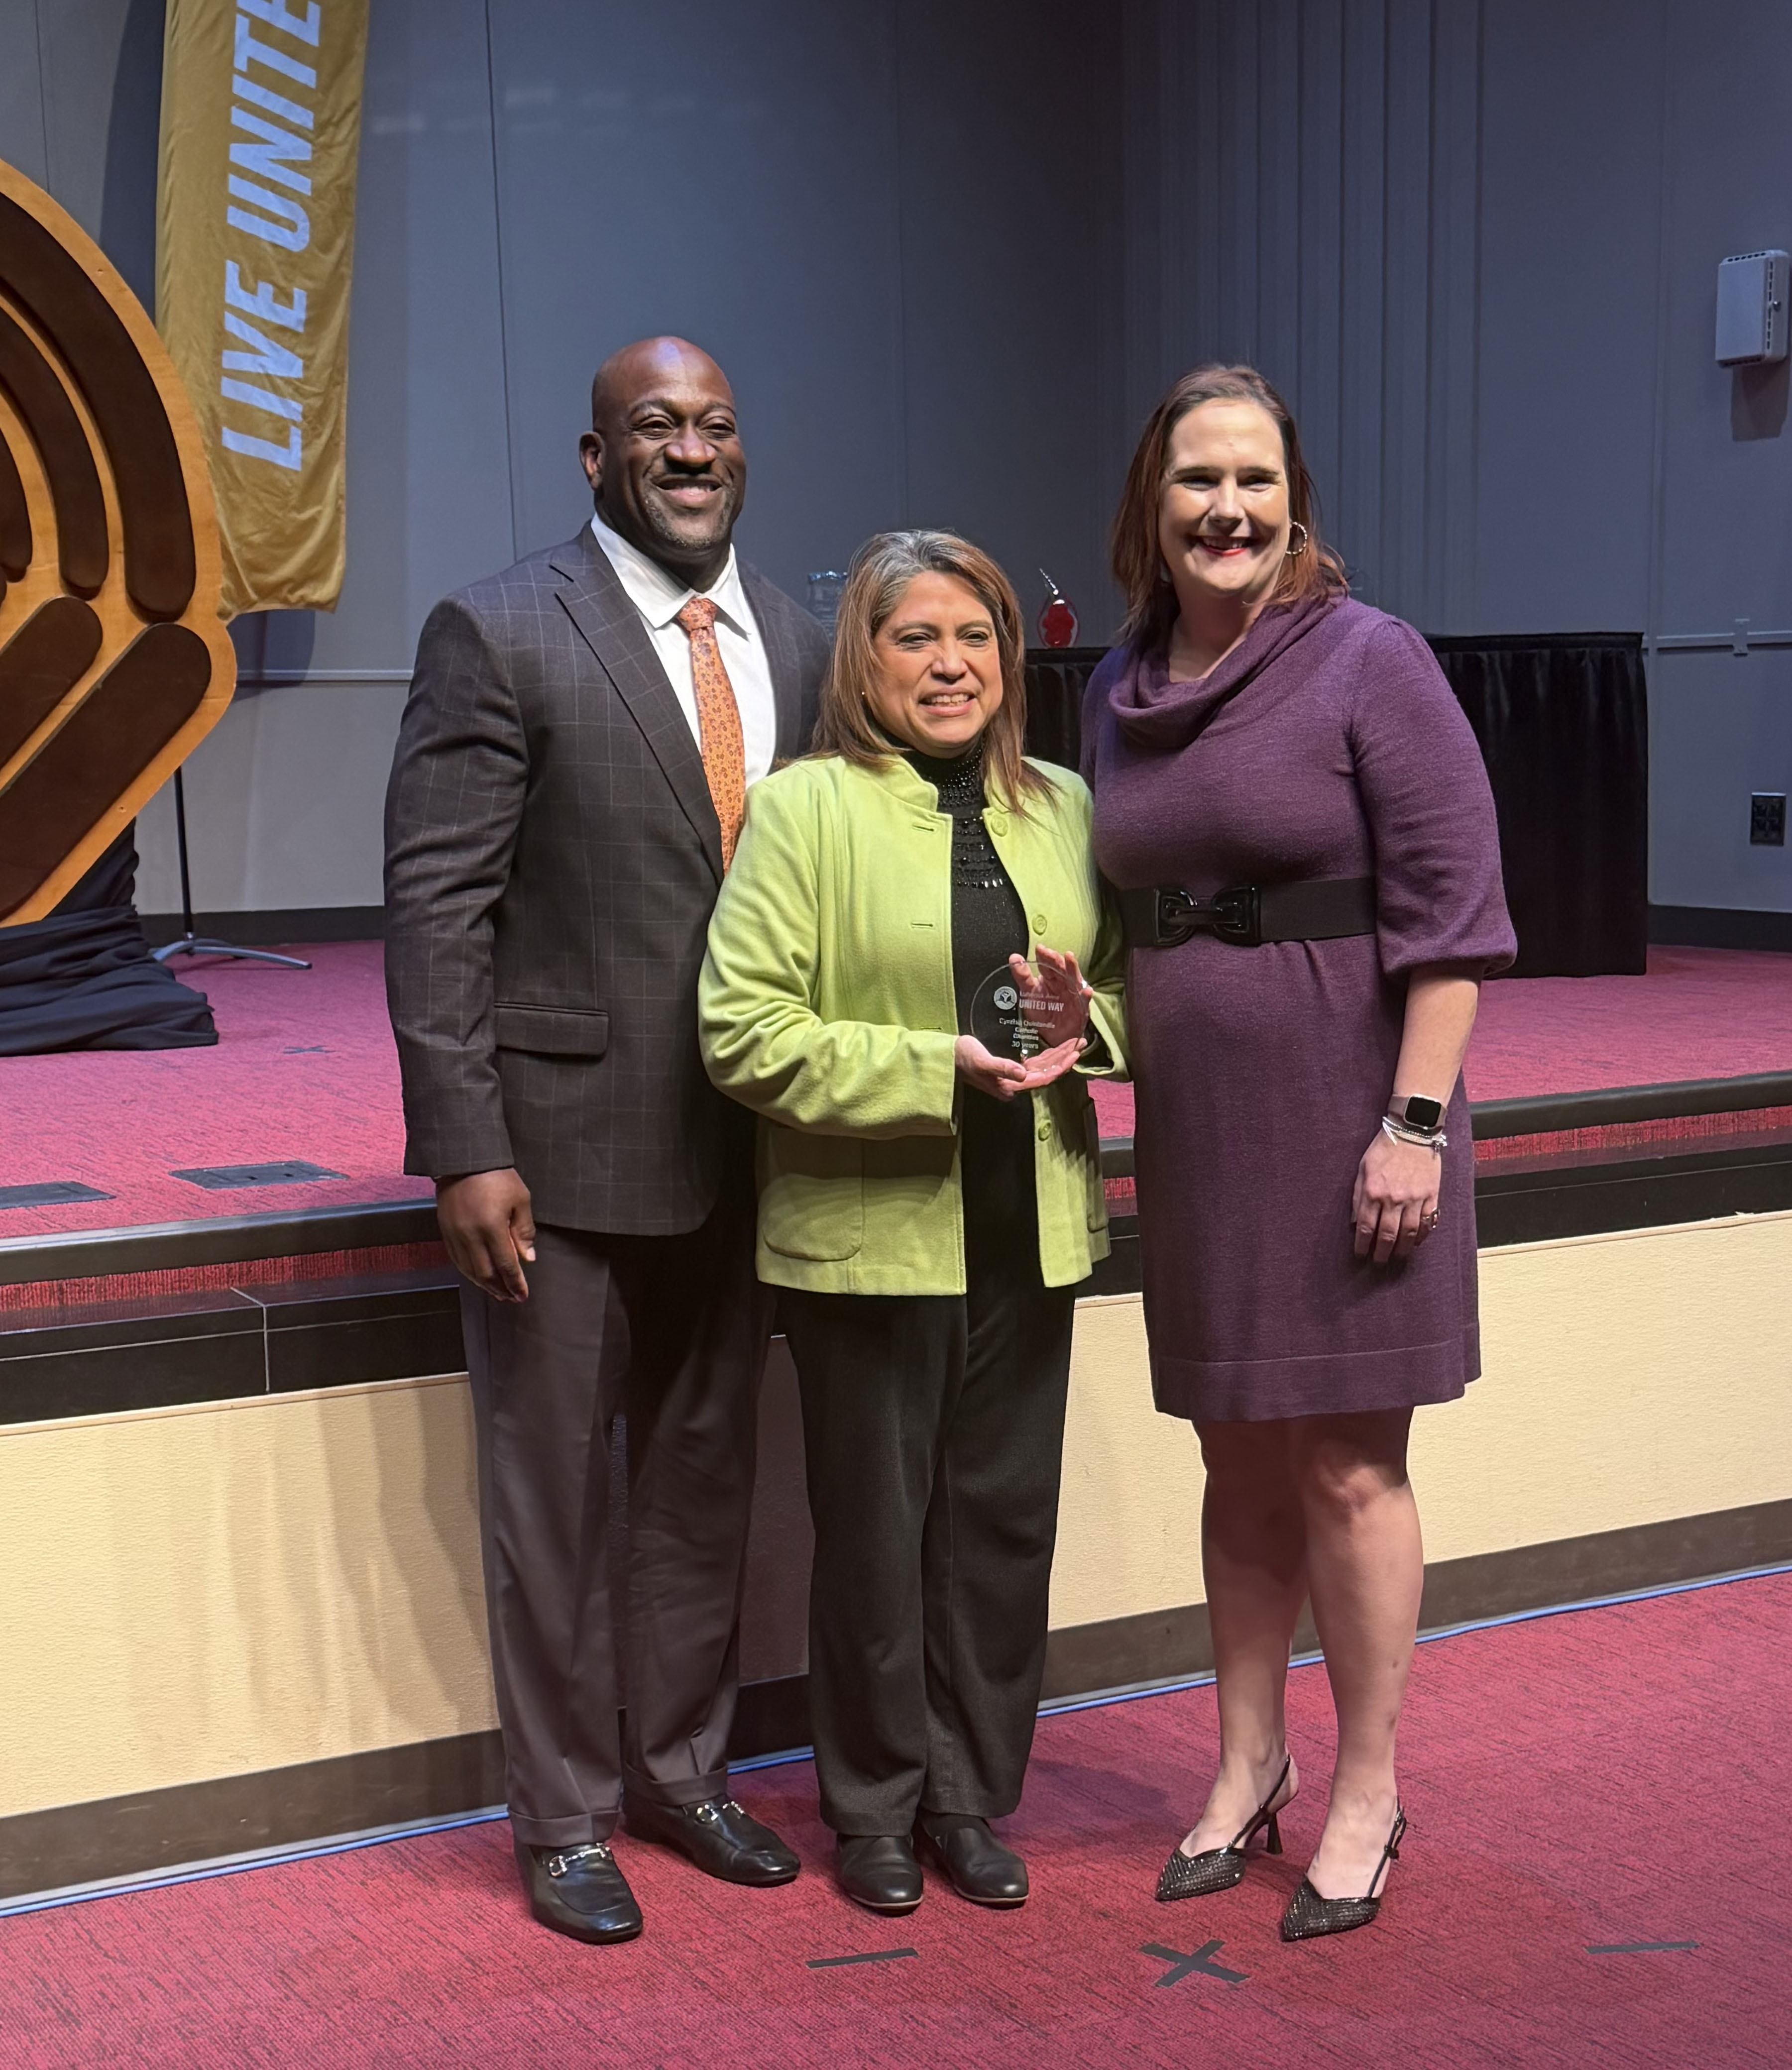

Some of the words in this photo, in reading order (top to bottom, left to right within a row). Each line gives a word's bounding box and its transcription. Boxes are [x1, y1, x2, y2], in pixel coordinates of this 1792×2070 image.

[221, 259, 307, 471] LIVE
[1019, 998, 1046, 1010] UNITED
[1047, 1002, 1064, 1012] WAY
